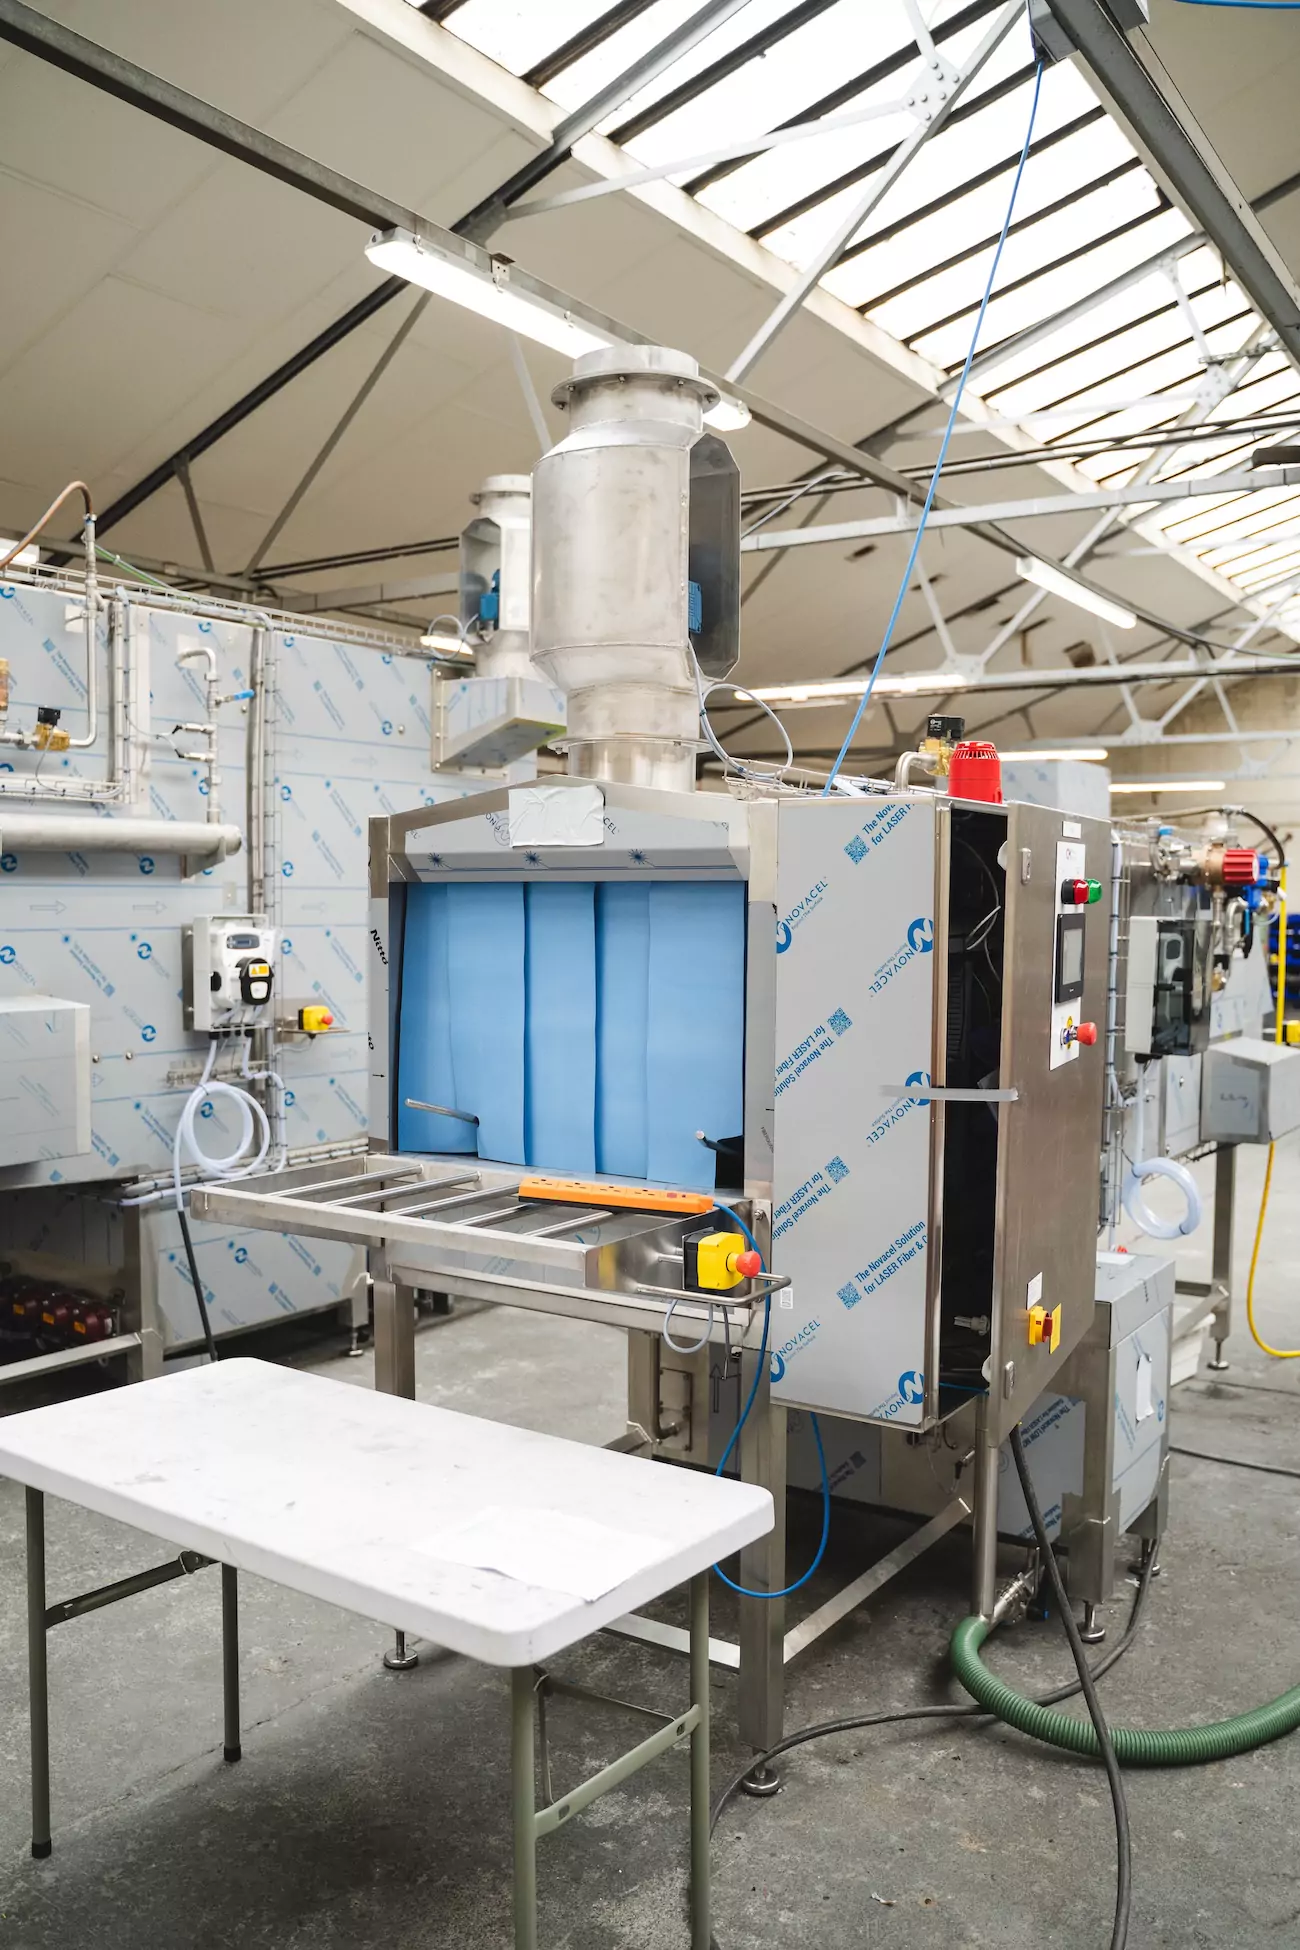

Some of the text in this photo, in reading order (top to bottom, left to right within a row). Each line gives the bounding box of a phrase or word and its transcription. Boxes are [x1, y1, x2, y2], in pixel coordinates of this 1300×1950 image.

[862, 819, 878, 834] The
[871, 832, 884, 846] for
[881, 807, 907, 834] LASER
[785, 880, 828, 926] NOVACEL
[370, 929, 389, 965] Nitto
[869, 948, 915, 994] NOVACEL
[775, 1025, 826, 1076] for LASER Fiber
[794, 1048, 821, 1077] Novacel
[820, 1037, 834, 1050] The
[866, 1100, 911, 1144] NOVACEL
[773, 1171, 823, 1219] for LASER Fiber
[791, 1194, 819, 1222] Novacel
[817, 1183, 832, 1197] The
[854, 1221, 926, 1283] The Novacel Solution
[863, 1282, 876, 1295] for
[874, 1262, 900, 1286] LASER
[896, 1246, 917, 1266] Fiber
[915, 1241, 924, 1250] &
[779, 1319, 820, 1358] NOVACEL
